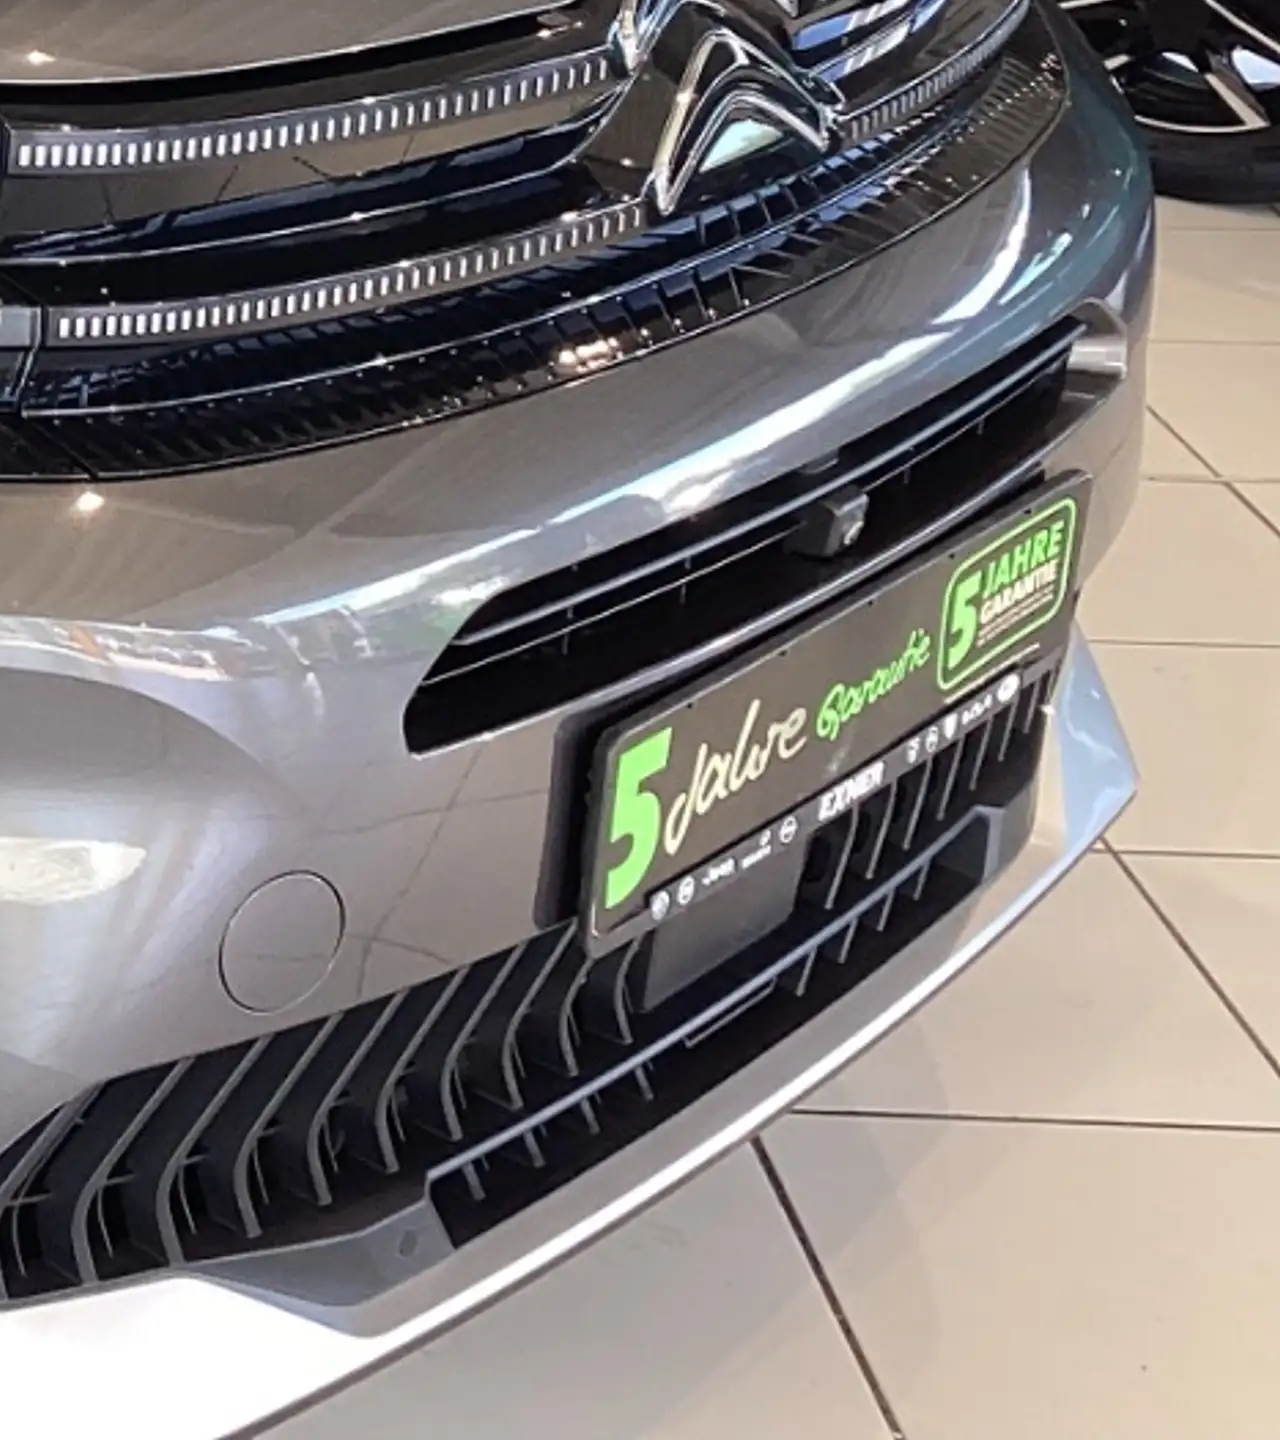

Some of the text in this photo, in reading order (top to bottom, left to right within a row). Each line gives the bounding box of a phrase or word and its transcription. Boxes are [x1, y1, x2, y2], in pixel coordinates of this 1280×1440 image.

[947, 569, 983, 670] 5
[982, 519, 1066, 600] JAHRE
[605, 727, 673, 909] 5
[663, 698, 808, 856] Jahre
